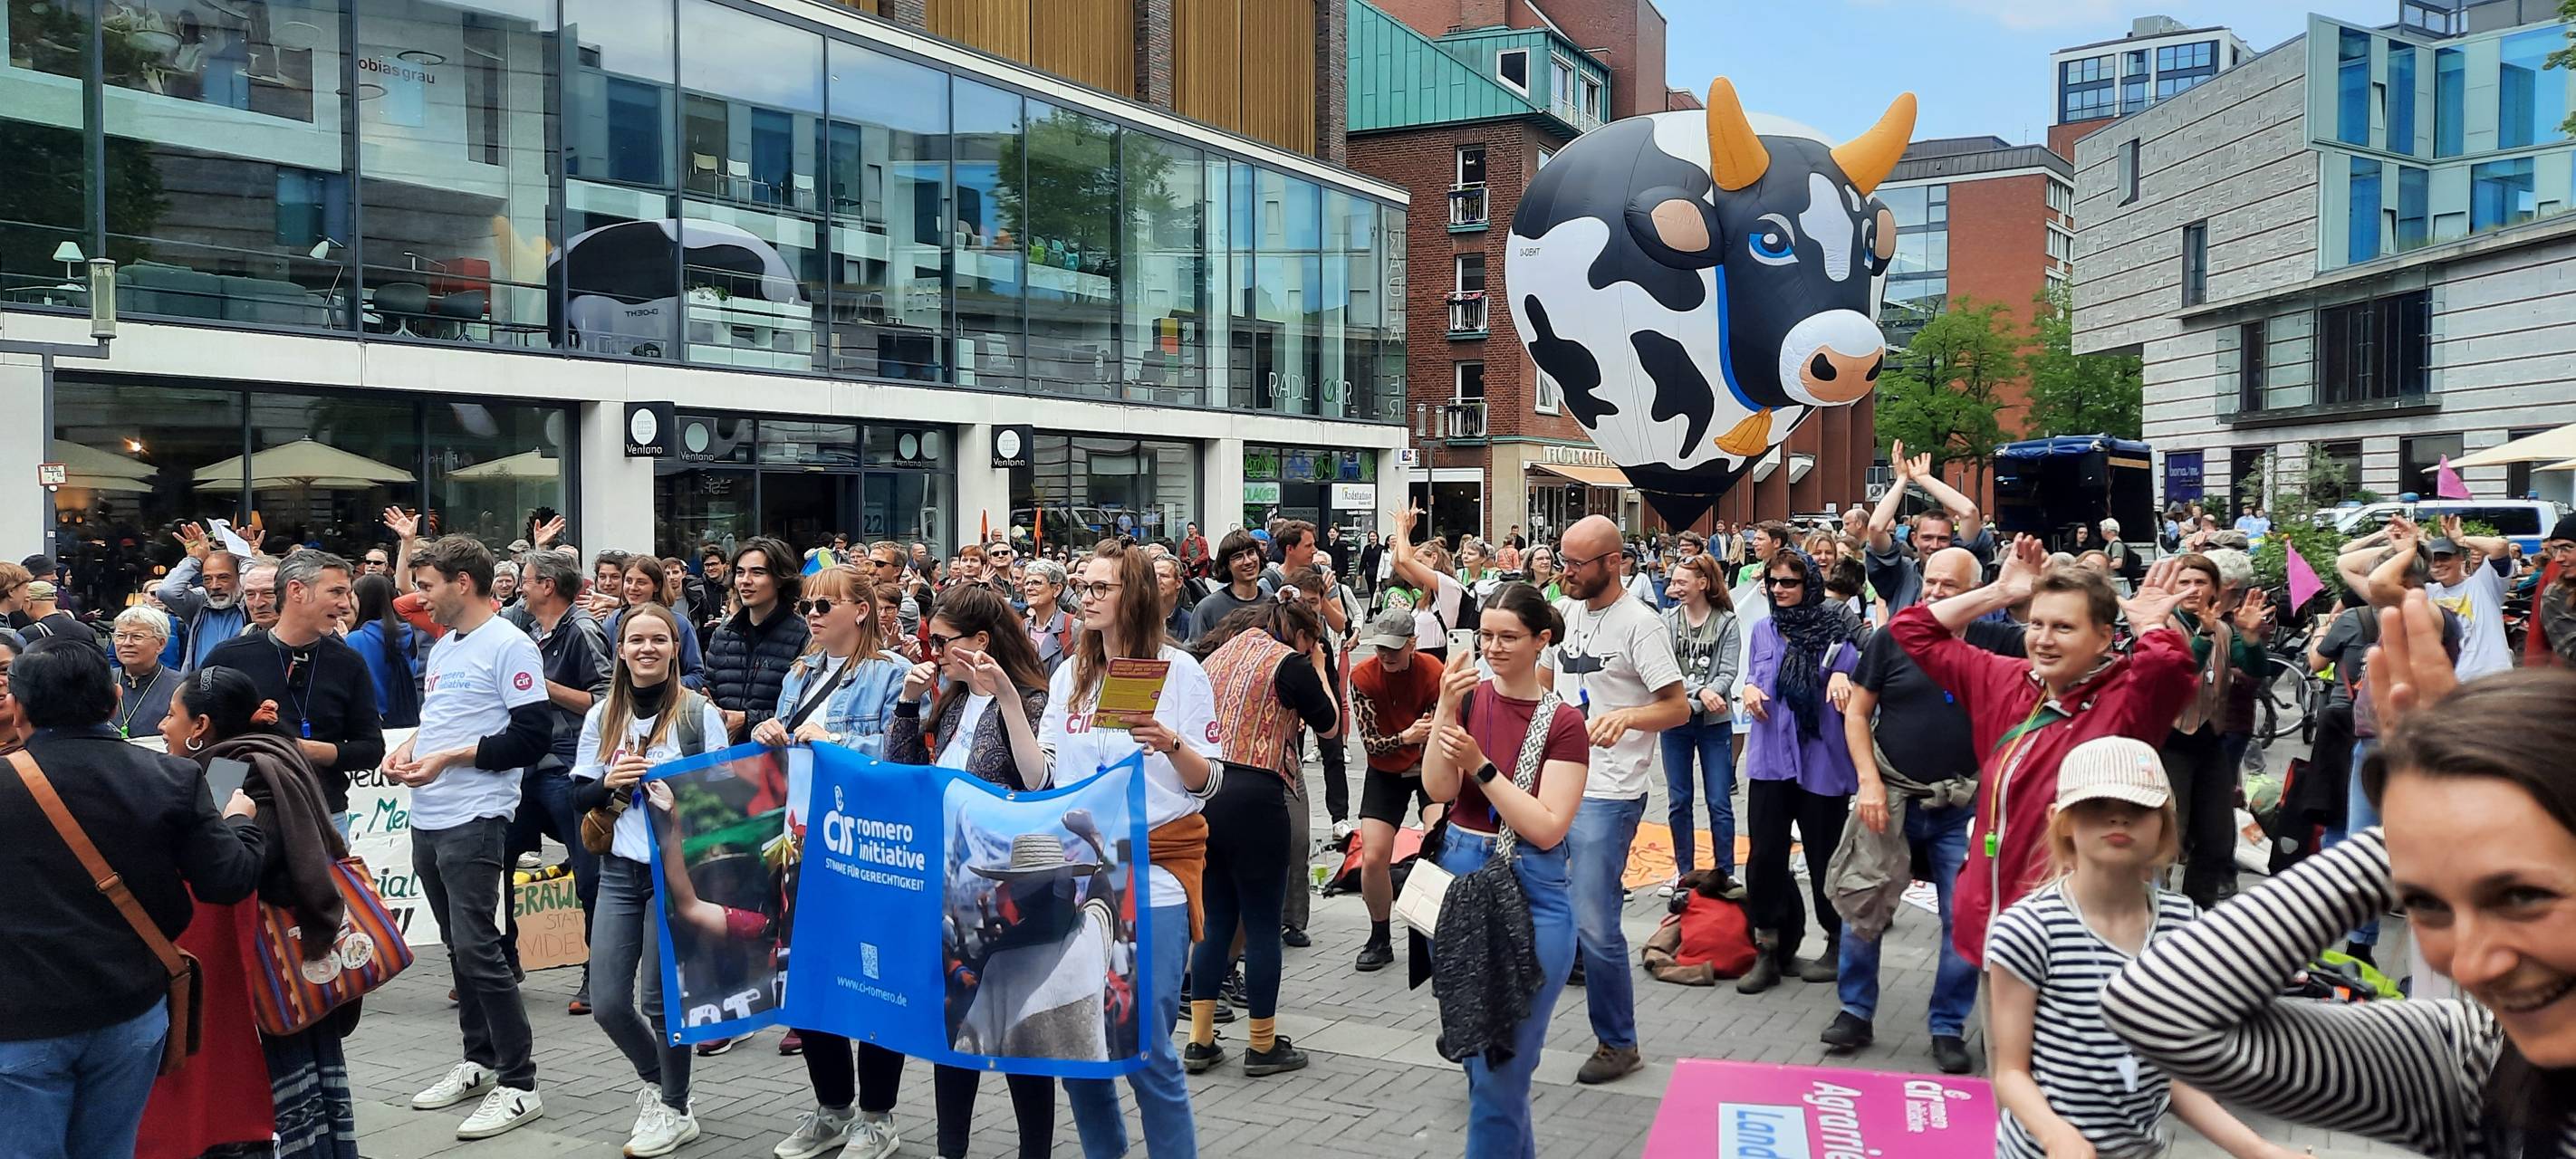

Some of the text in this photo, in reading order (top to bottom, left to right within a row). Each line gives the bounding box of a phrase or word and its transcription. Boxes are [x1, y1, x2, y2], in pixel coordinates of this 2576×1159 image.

[401, 68, 435, 84] grau
[626, 444, 663, 455] Ventana
[680, 451, 714, 461] Ventana
[895, 458, 922, 467] Ventana
[993, 457, 1025, 466] Ventana
[863, 513, 883, 534] 22
[856, 818, 913, 843] romero
[859, 838, 925, 871] initiative
[373, 867, 420, 899] ial
[825, 857, 925, 892] STIMME FÜR GERECHTIGKEIT
[523, 932, 584, 957] VIDE
[837, 975, 908, 1007] www.ci-romero.de
